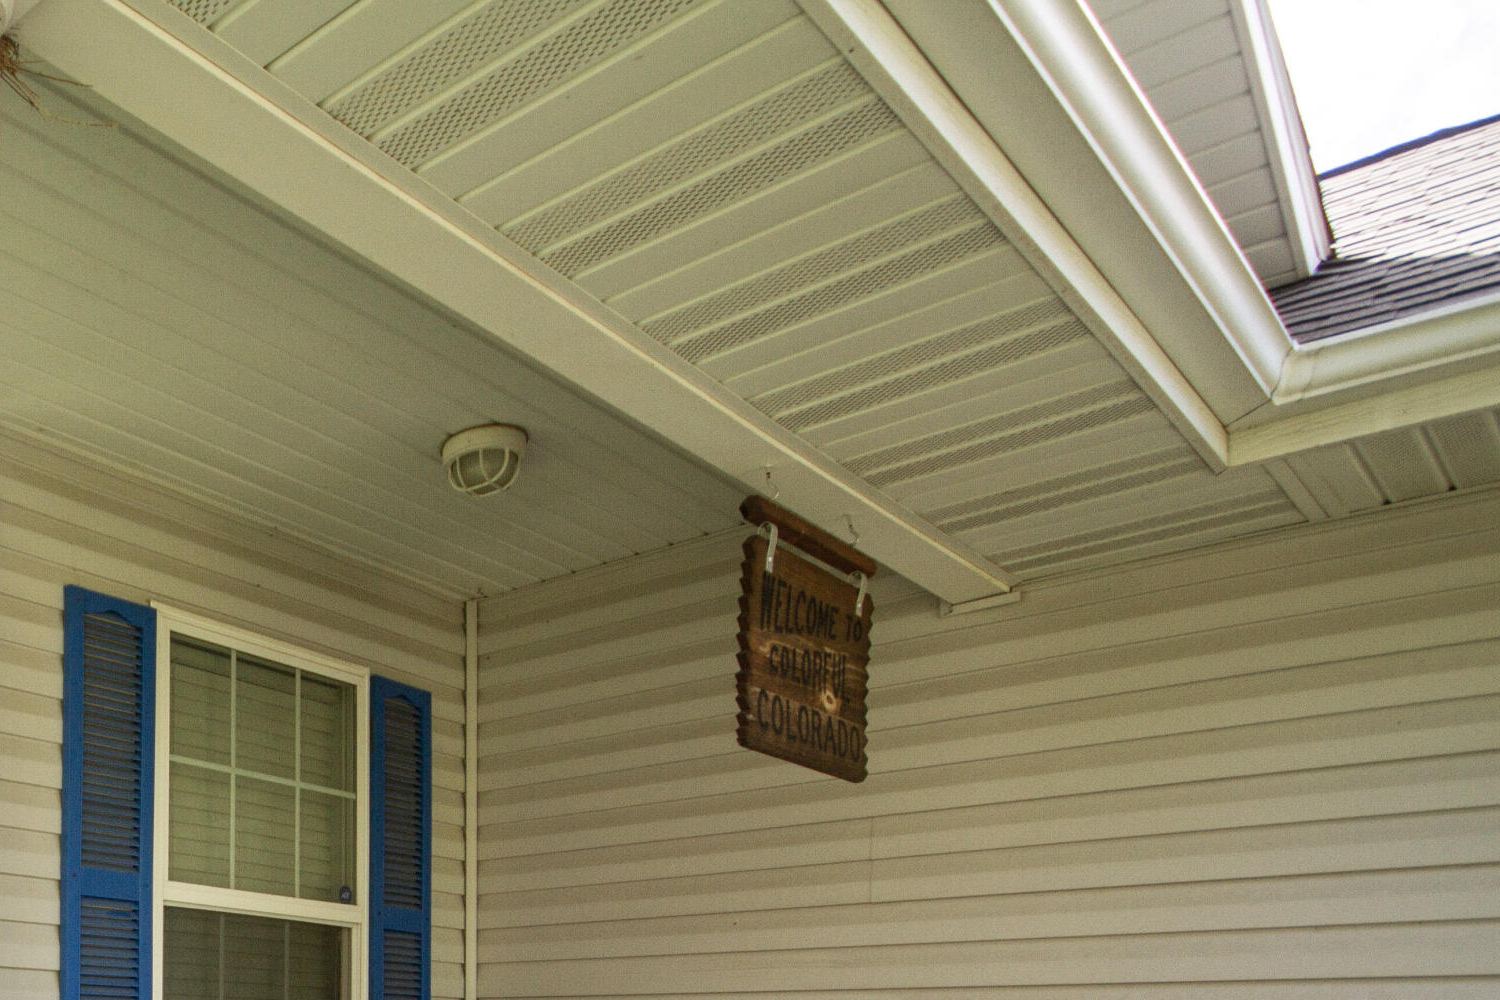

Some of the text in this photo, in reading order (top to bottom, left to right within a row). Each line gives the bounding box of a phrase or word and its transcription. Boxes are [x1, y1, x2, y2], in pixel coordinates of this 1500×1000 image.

[760, 570, 863, 641] WELCOME TO
[757, 688, 861, 762] COLORADO
